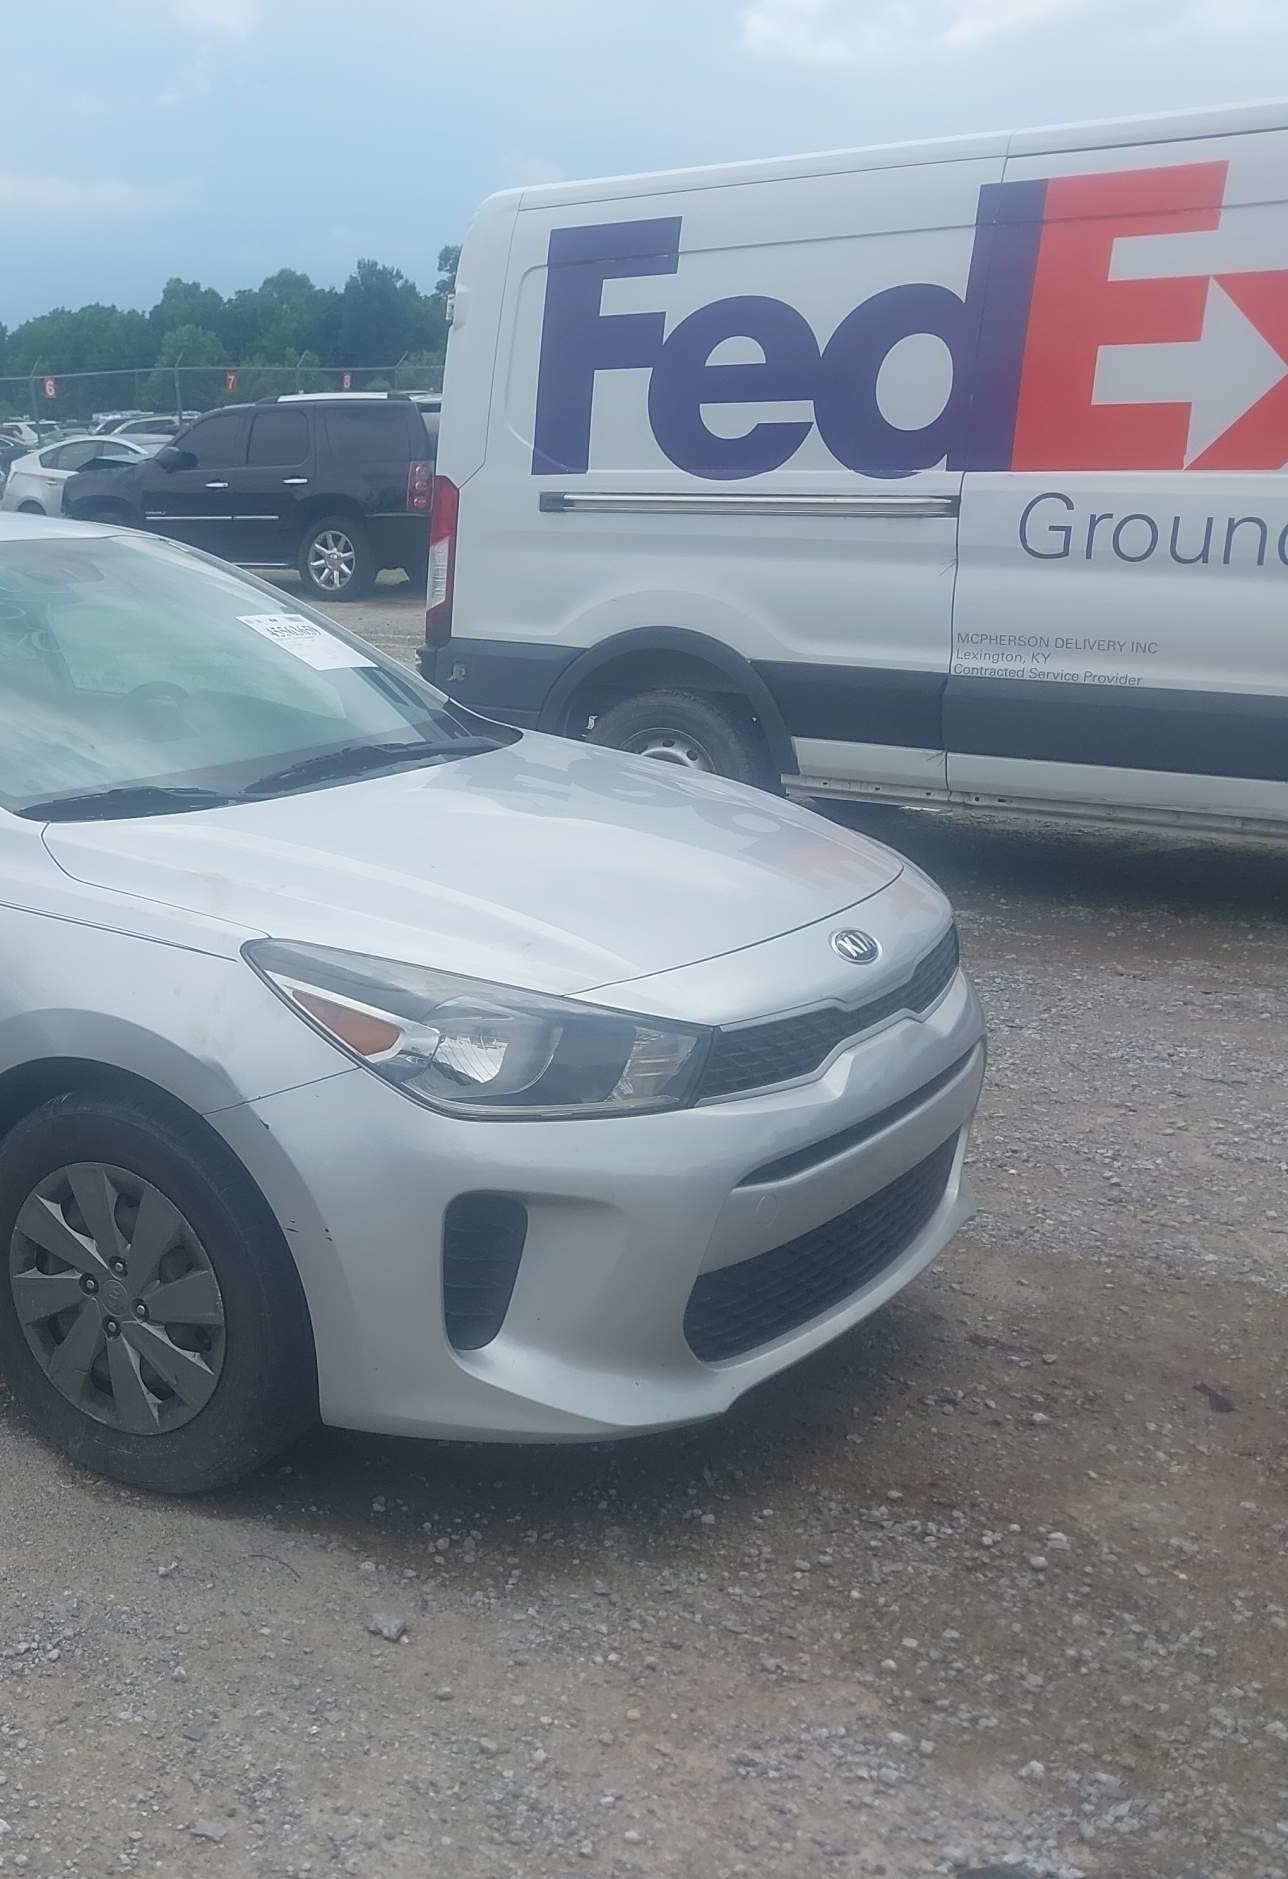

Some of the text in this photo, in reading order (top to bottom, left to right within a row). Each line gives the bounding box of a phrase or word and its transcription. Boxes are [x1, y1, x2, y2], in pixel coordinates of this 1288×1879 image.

[45, 379, 56, 396] 6
[226, 375, 235, 390] 7
[956, 632, 1160, 655] MCPHERSON DELIVERY INC
[955, 648, 1052, 665] Lexington, KY
[953, 663, 1144, 687] Contracted Service Provider
